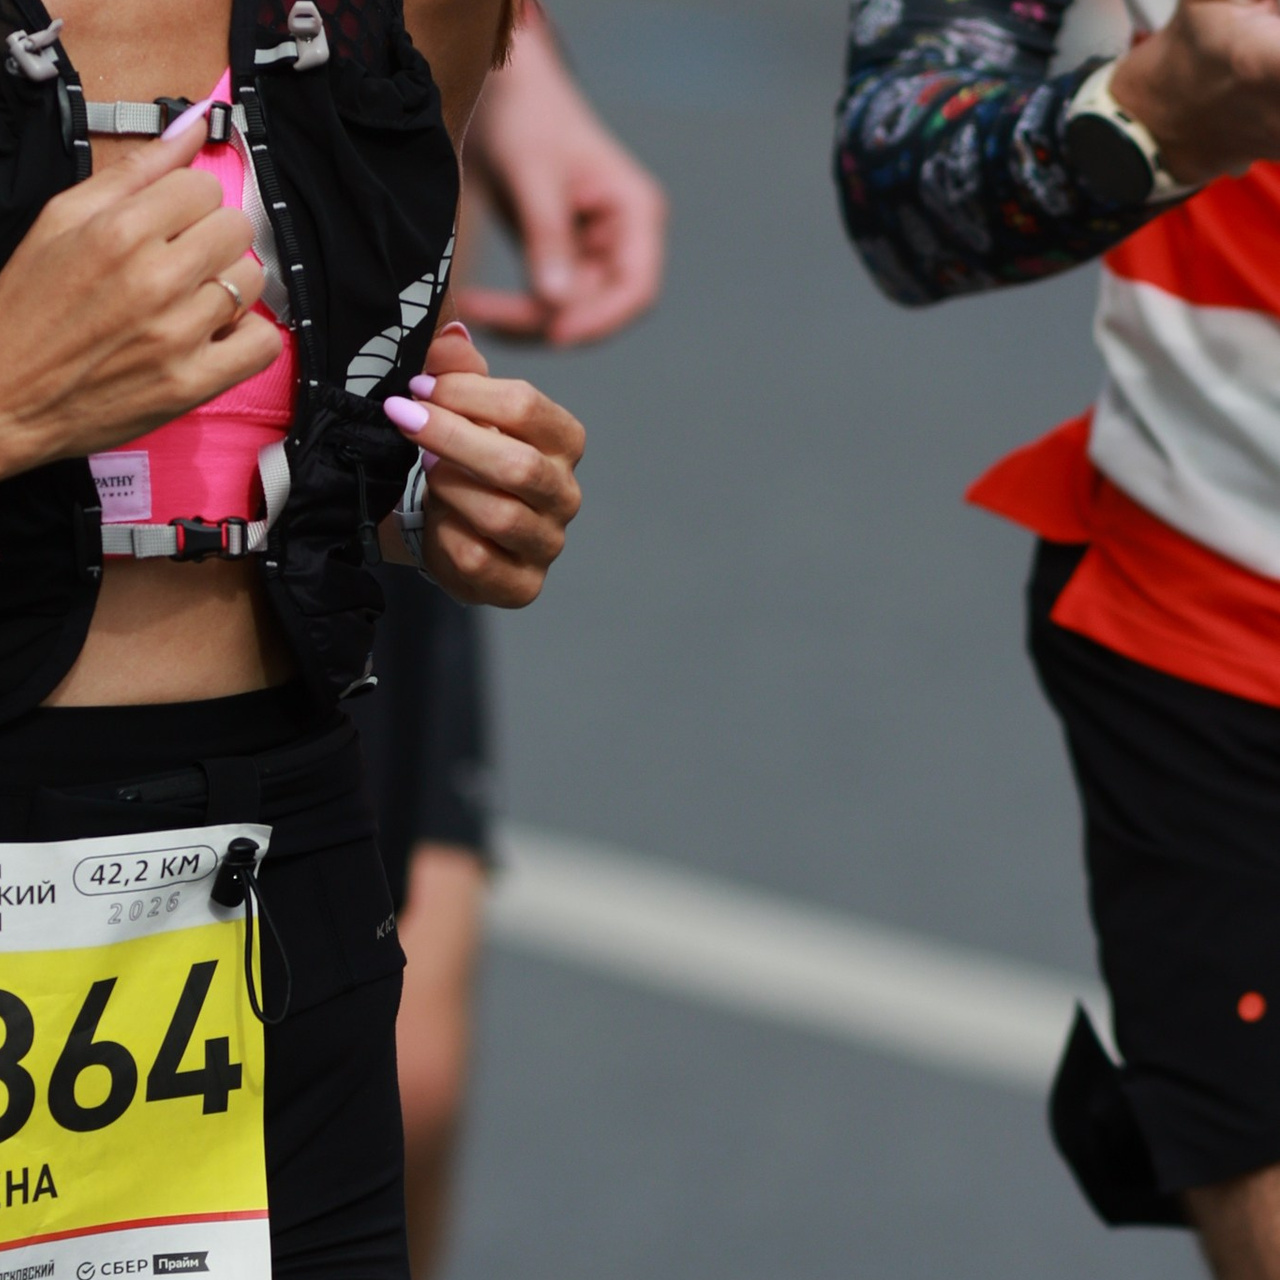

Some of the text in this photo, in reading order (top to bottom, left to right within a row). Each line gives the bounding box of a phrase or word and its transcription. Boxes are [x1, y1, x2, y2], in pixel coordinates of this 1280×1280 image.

[90, 860, 149, 887] 42,2
[100, 1257, 200, 1276] СБЕР Прайм
